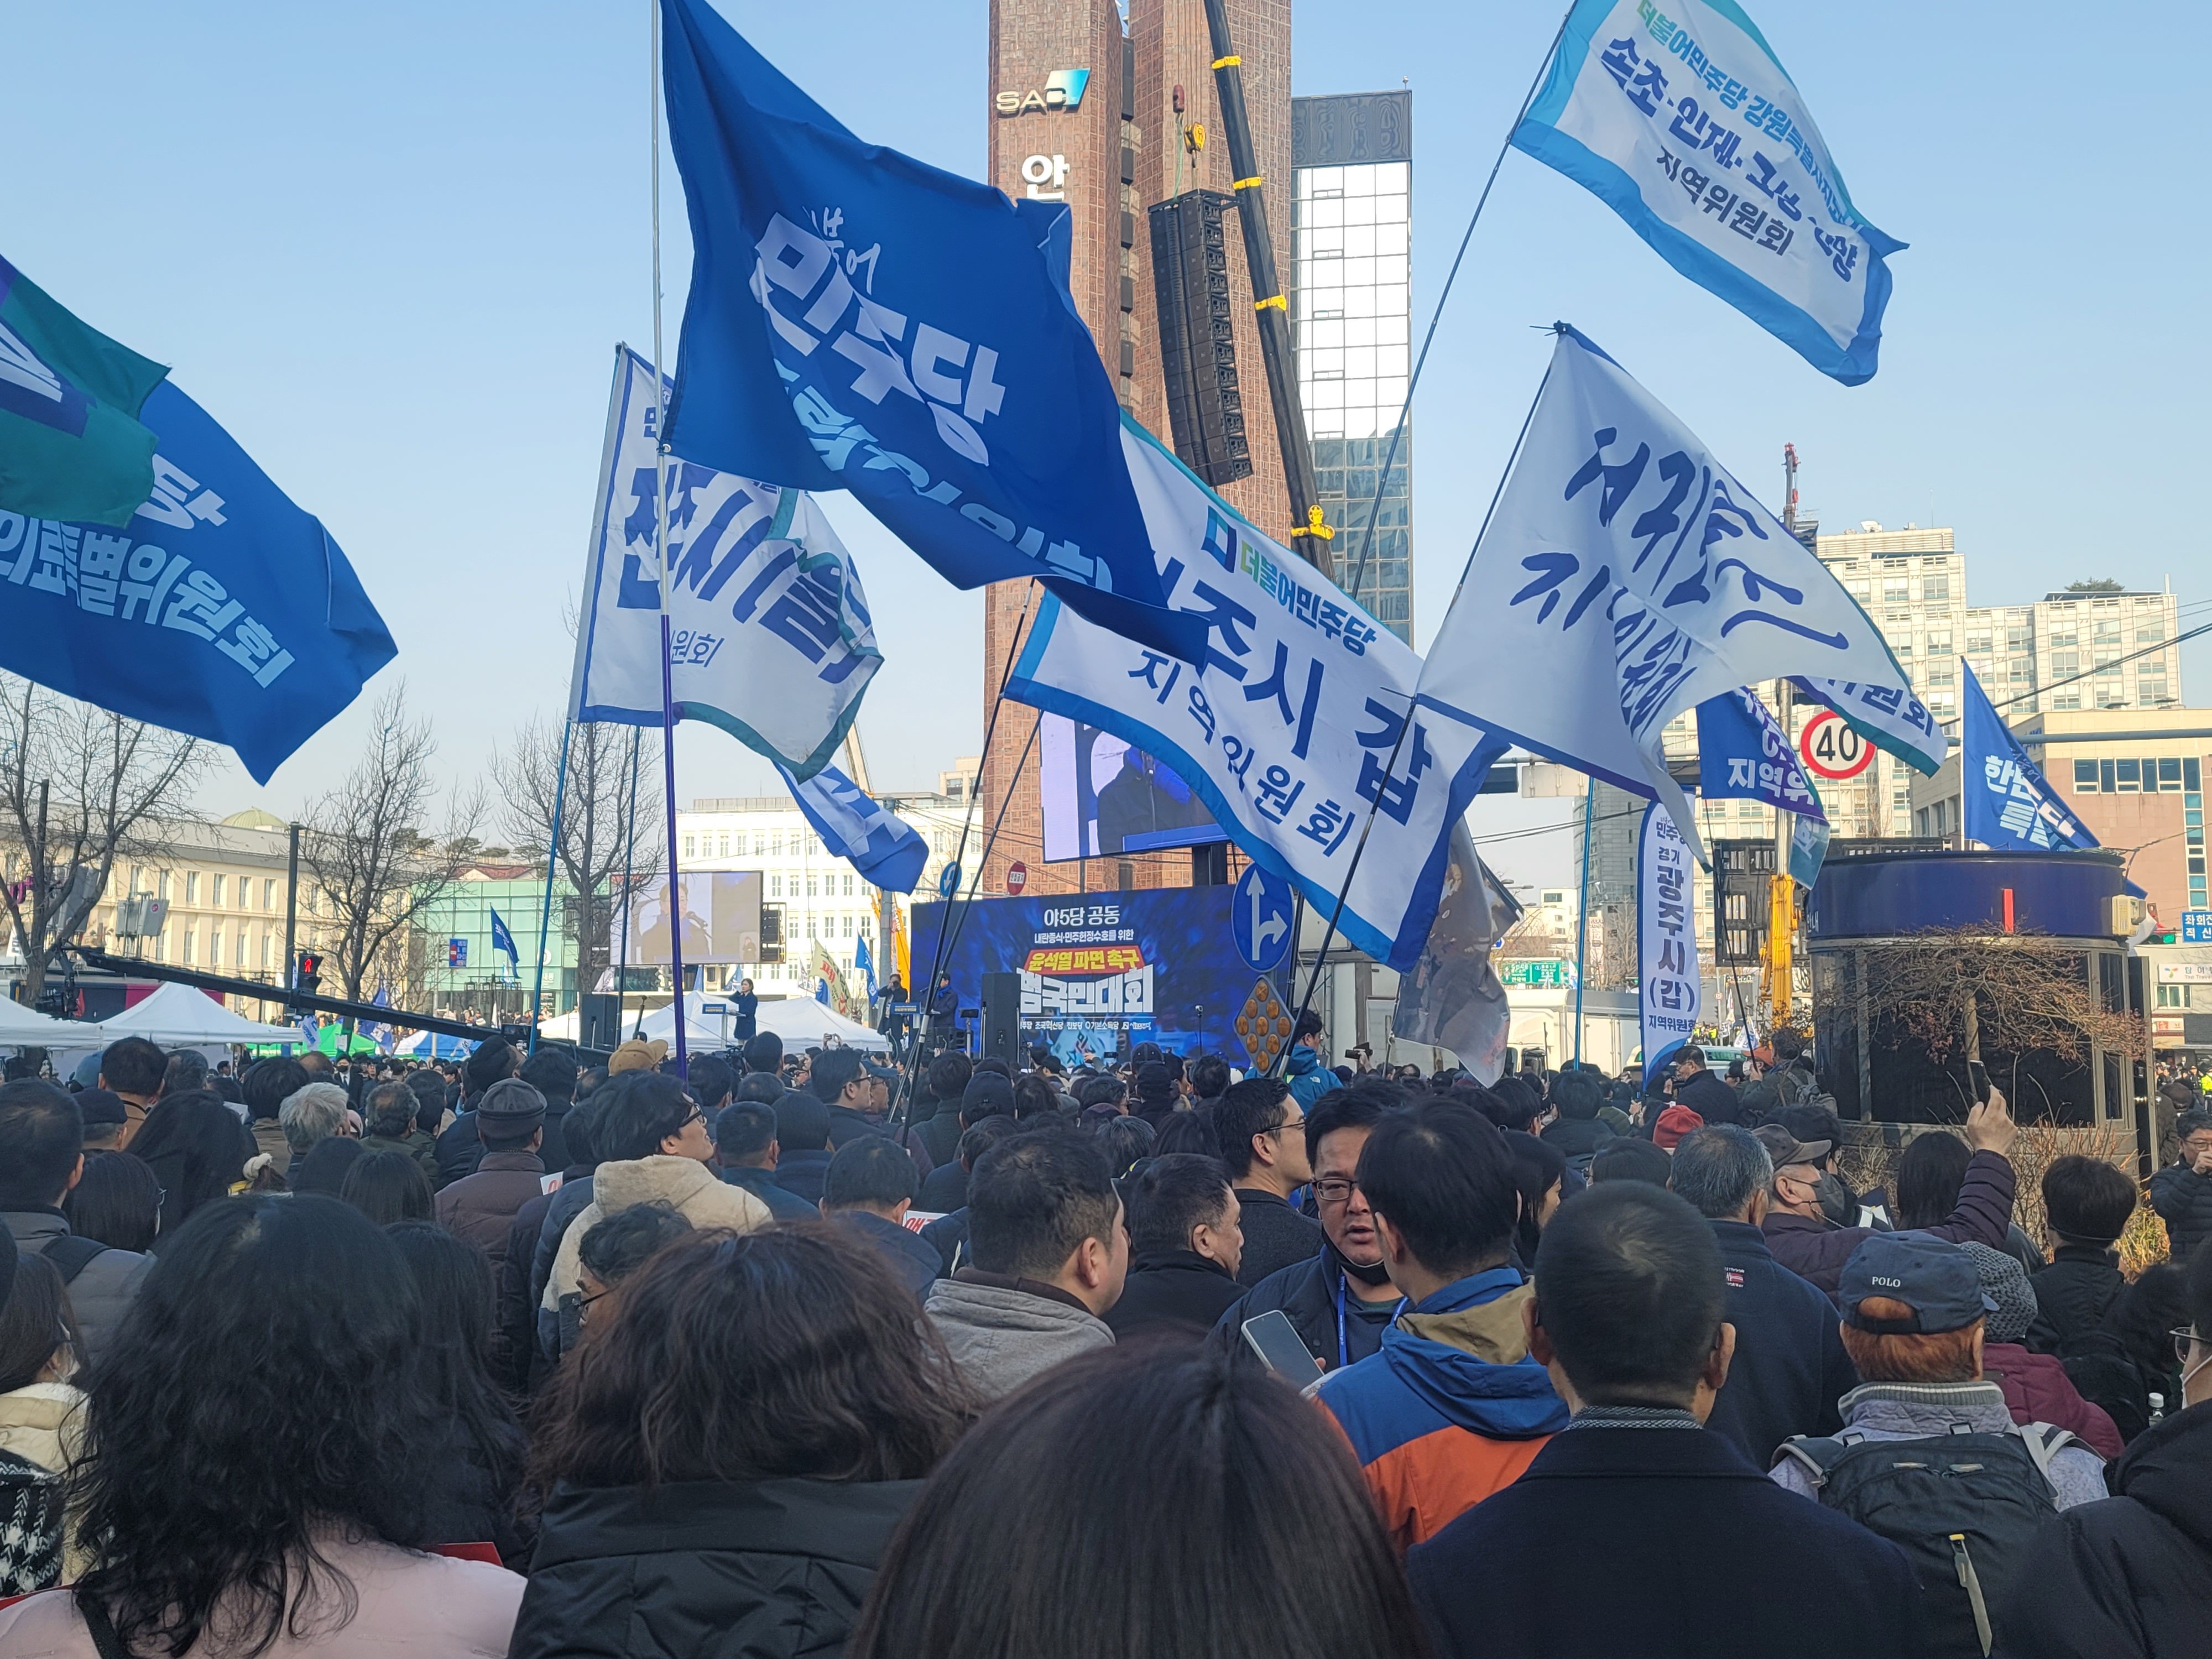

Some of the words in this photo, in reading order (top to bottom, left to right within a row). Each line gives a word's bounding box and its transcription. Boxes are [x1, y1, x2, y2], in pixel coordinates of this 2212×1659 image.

[1636, 0, 1748, 109] 더불어민주당
[1656, 144, 1794, 256] 지역위원회
[1240, 540, 1377, 657] 더불어민주당
[1128, 650, 1357, 858] 지역위원회
[1816, 724, 1859, 761] 40
[1354, 696, 1433, 826] 갑
[1658, 846, 1680, 865] 경기
[1044, 907, 1085, 927] 야5당
[1087, 905, 1120, 925] 공동
[1118, 928, 1134, 941] 위한
[1028, 951, 1072, 971] 윤석열
[1073, 950, 1105, 970] 파면
[1107, 949, 1140, 969] 촉구
[1017, 964, 1154, 1014] 범국민대회
[1035, 1020, 1064, 1030] 조국혁신당
[1067, 1021, 1083, 1030] 진보당
[1648, 1014, 1696, 1033] 지역위원회
[1871, 1276, 1901, 1288] POLO
